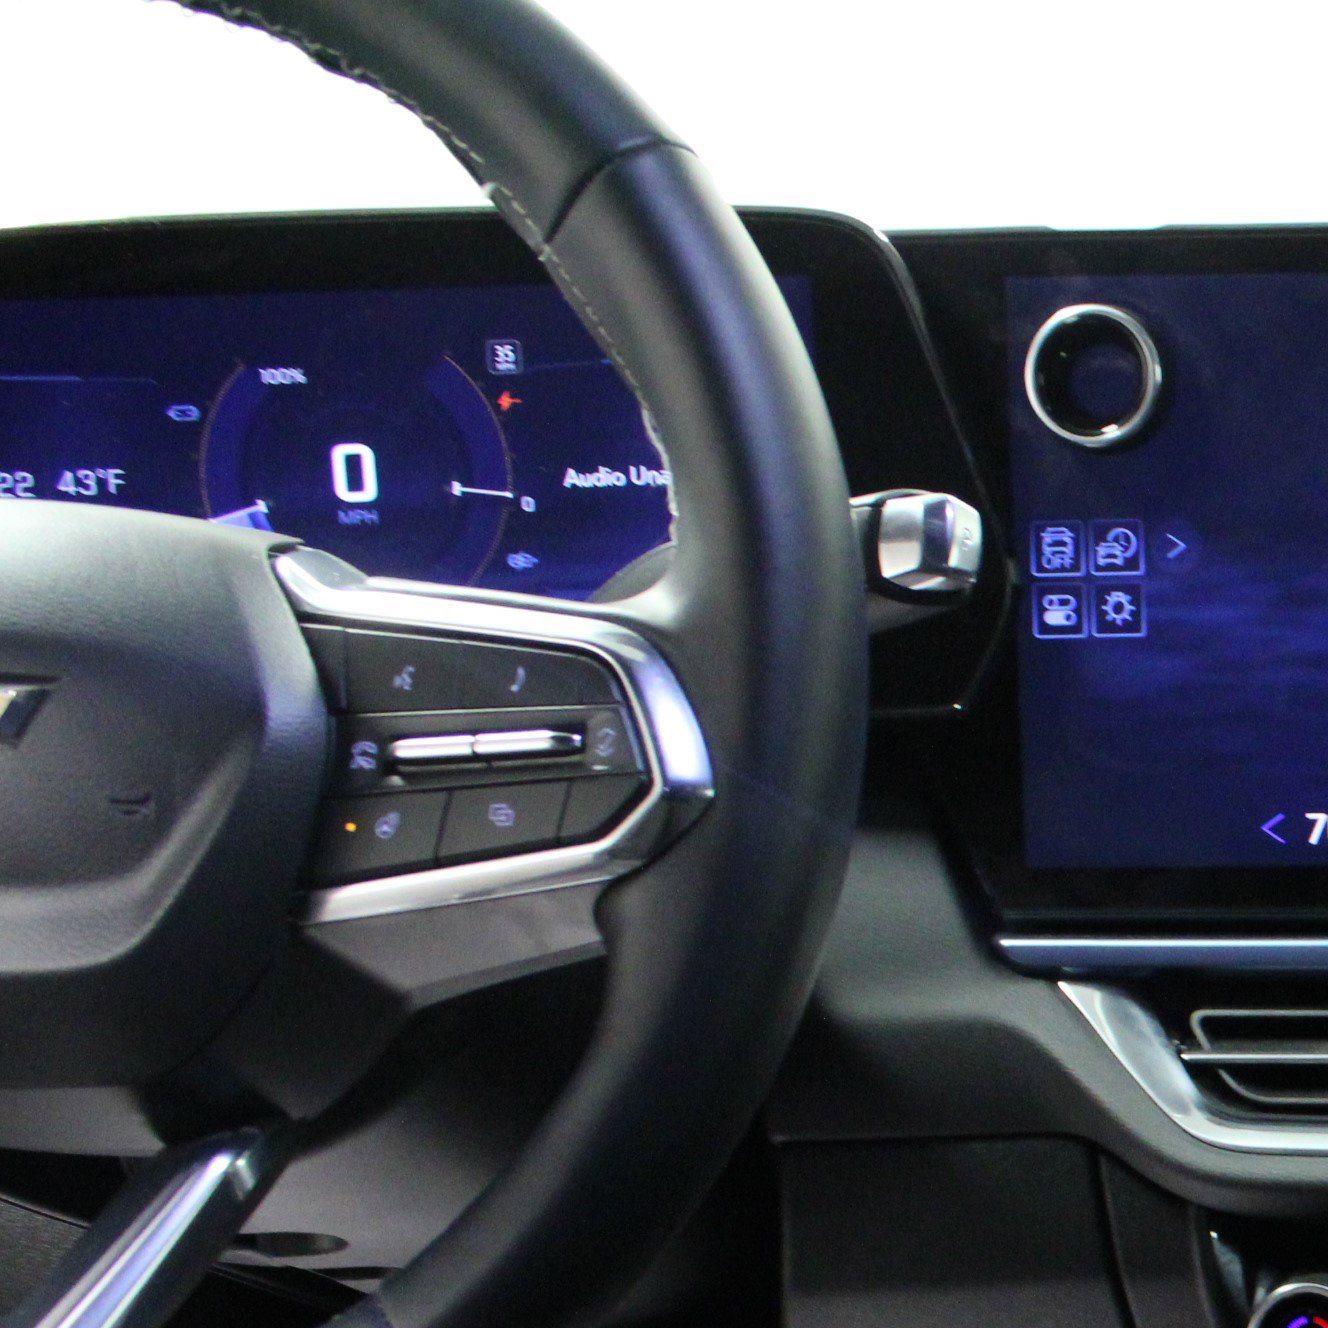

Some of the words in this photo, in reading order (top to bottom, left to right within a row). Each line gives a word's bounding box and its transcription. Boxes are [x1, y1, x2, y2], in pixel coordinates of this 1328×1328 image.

[258, 367, 308, 385] 100%
[56, 468, 127, 496] 43°F
[330, 443, 379, 503] 0
[563, 465, 627, 488] Audio
[520, 496, 536, 513] 0
[338, 508, 380, 525] MPH
